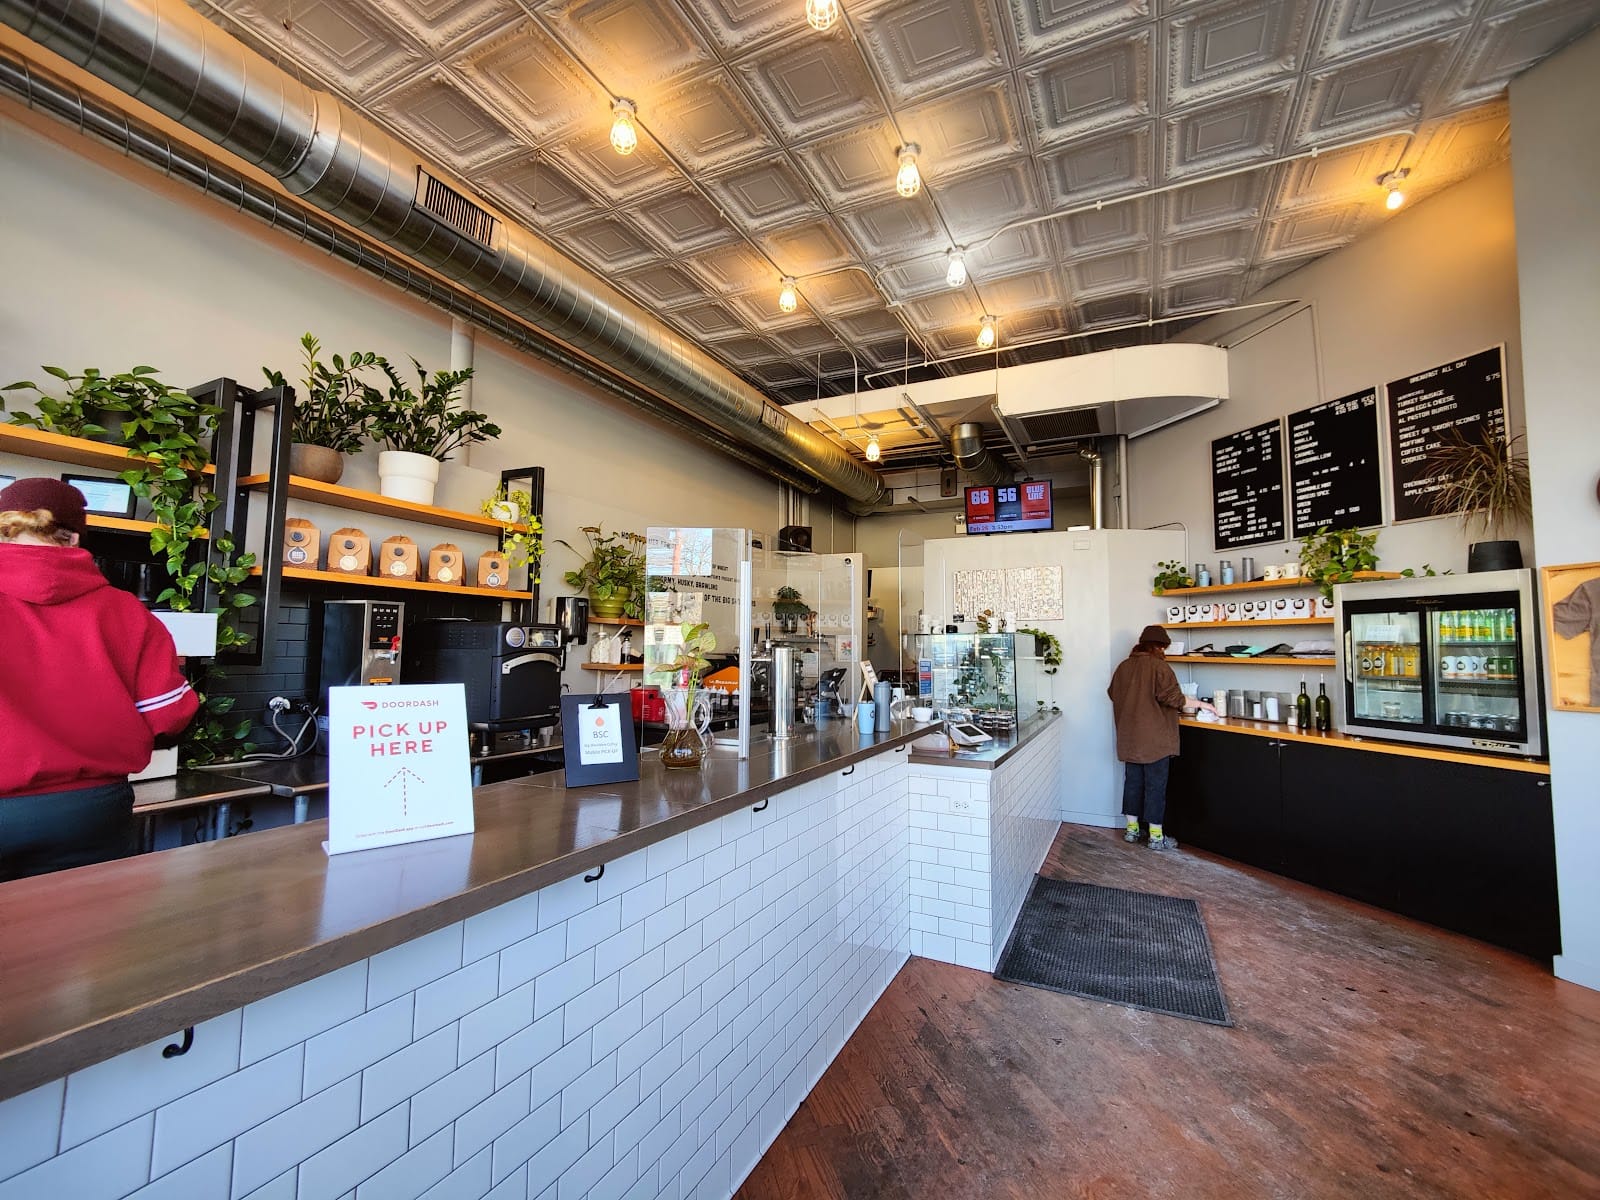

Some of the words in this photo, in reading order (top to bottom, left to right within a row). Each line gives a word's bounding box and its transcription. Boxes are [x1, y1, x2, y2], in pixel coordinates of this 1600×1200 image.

[1410, 370, 1438, 384] BREAKFAST
[1442, 365, 1453, 374] ALL
[1456, 360, 1467, 369] DAY
[1433, 395, 1455, 407] CHEESE
[1408, 411, 1430, 422] PASTOR
[1432, 403, 1457, 415] BURRITO
[1456, 414, 1480, 426] SCONES
[1401, 446, 1424, 457] COFFEE
[1402, 454, 1427, 464] COOKIES
[998, 488, 1016, 502] 56
[382, 699, 439, 709] DOORDASH
[352, 722, 410, 739] PICK
[419, 720, 448, 735] UP
[593, 731, 609, 739] BSC
[370, 739, 433, 757] HERE
